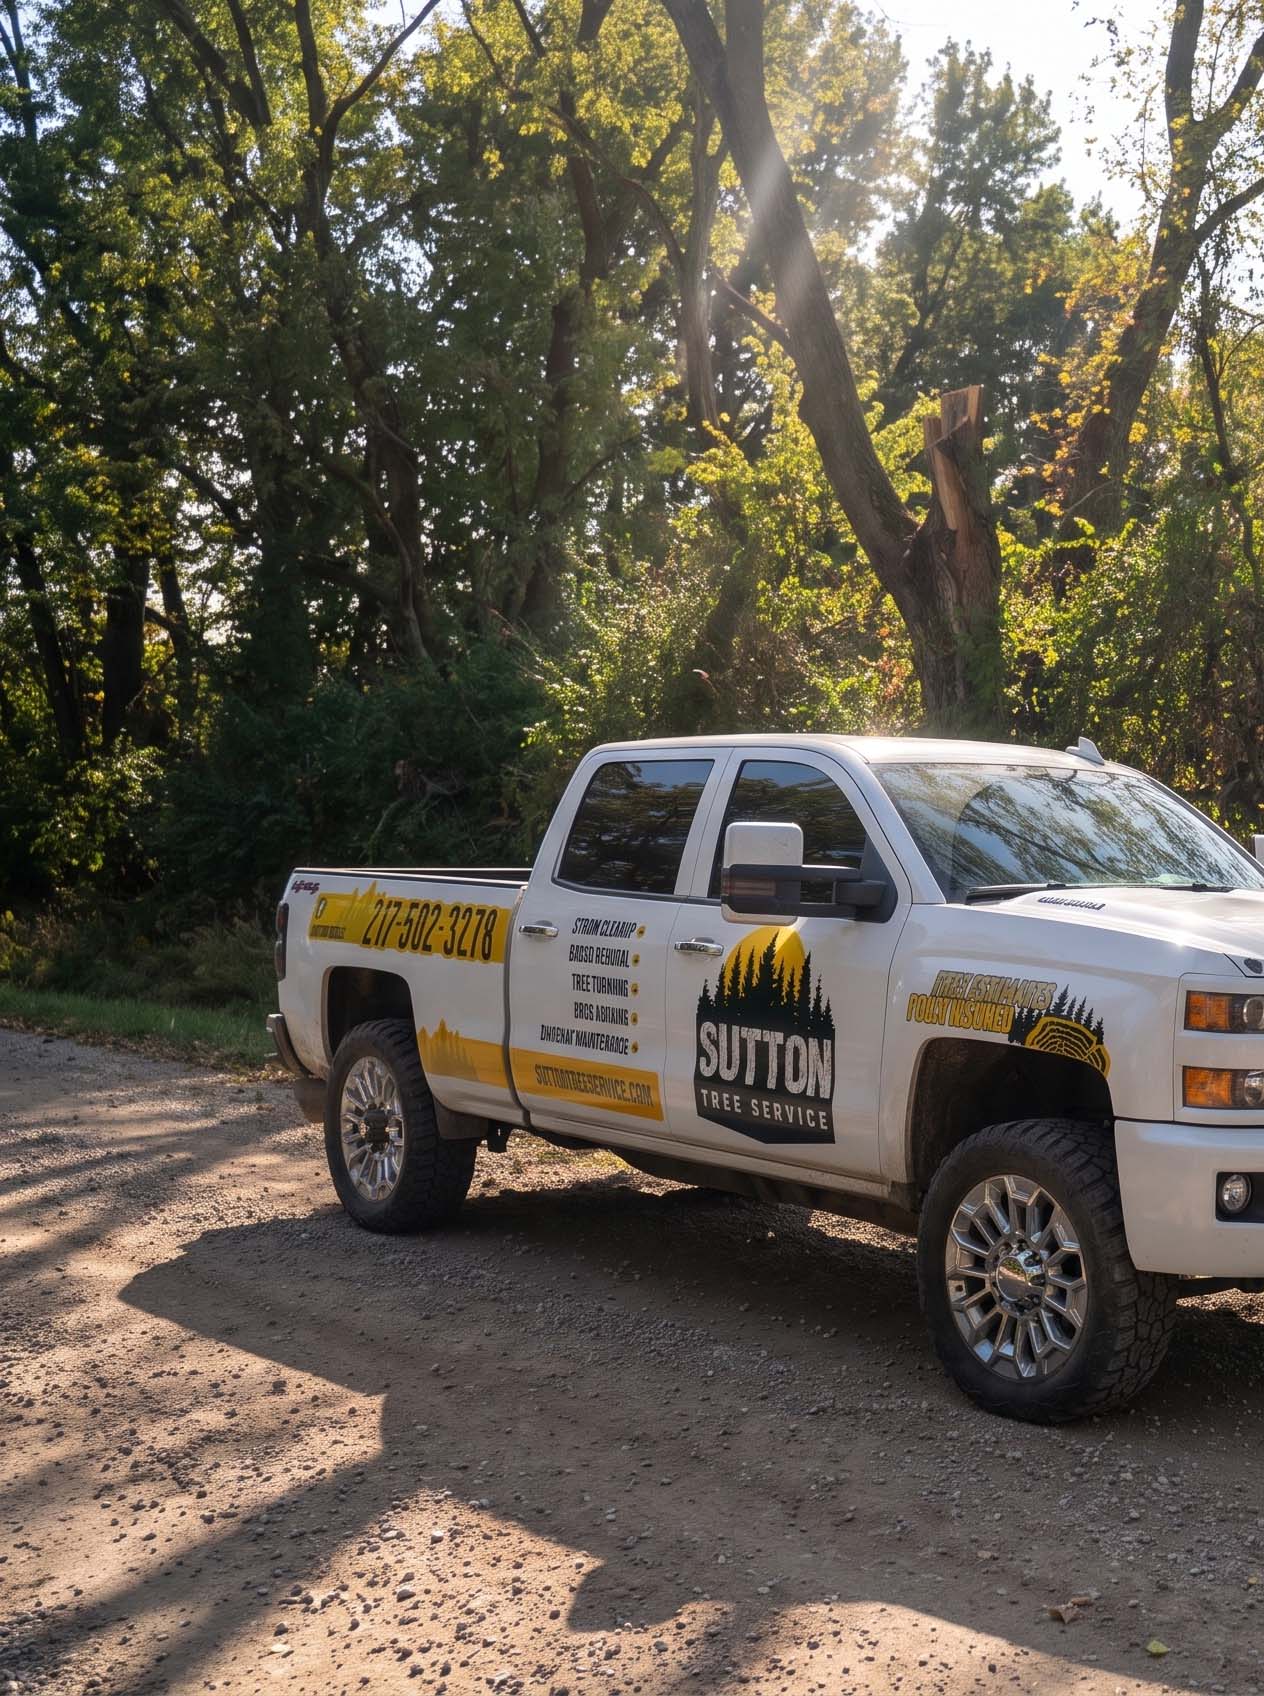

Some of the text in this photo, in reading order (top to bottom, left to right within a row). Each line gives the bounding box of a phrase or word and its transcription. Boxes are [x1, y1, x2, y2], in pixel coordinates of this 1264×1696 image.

[362, 898, 498, 960] 217-502-3278
[572, 973, 590, 992] TREE
[699, 1021, 832, 1099] SUTTON
[701, 1088, 828, 1130] TREE SERVICE
